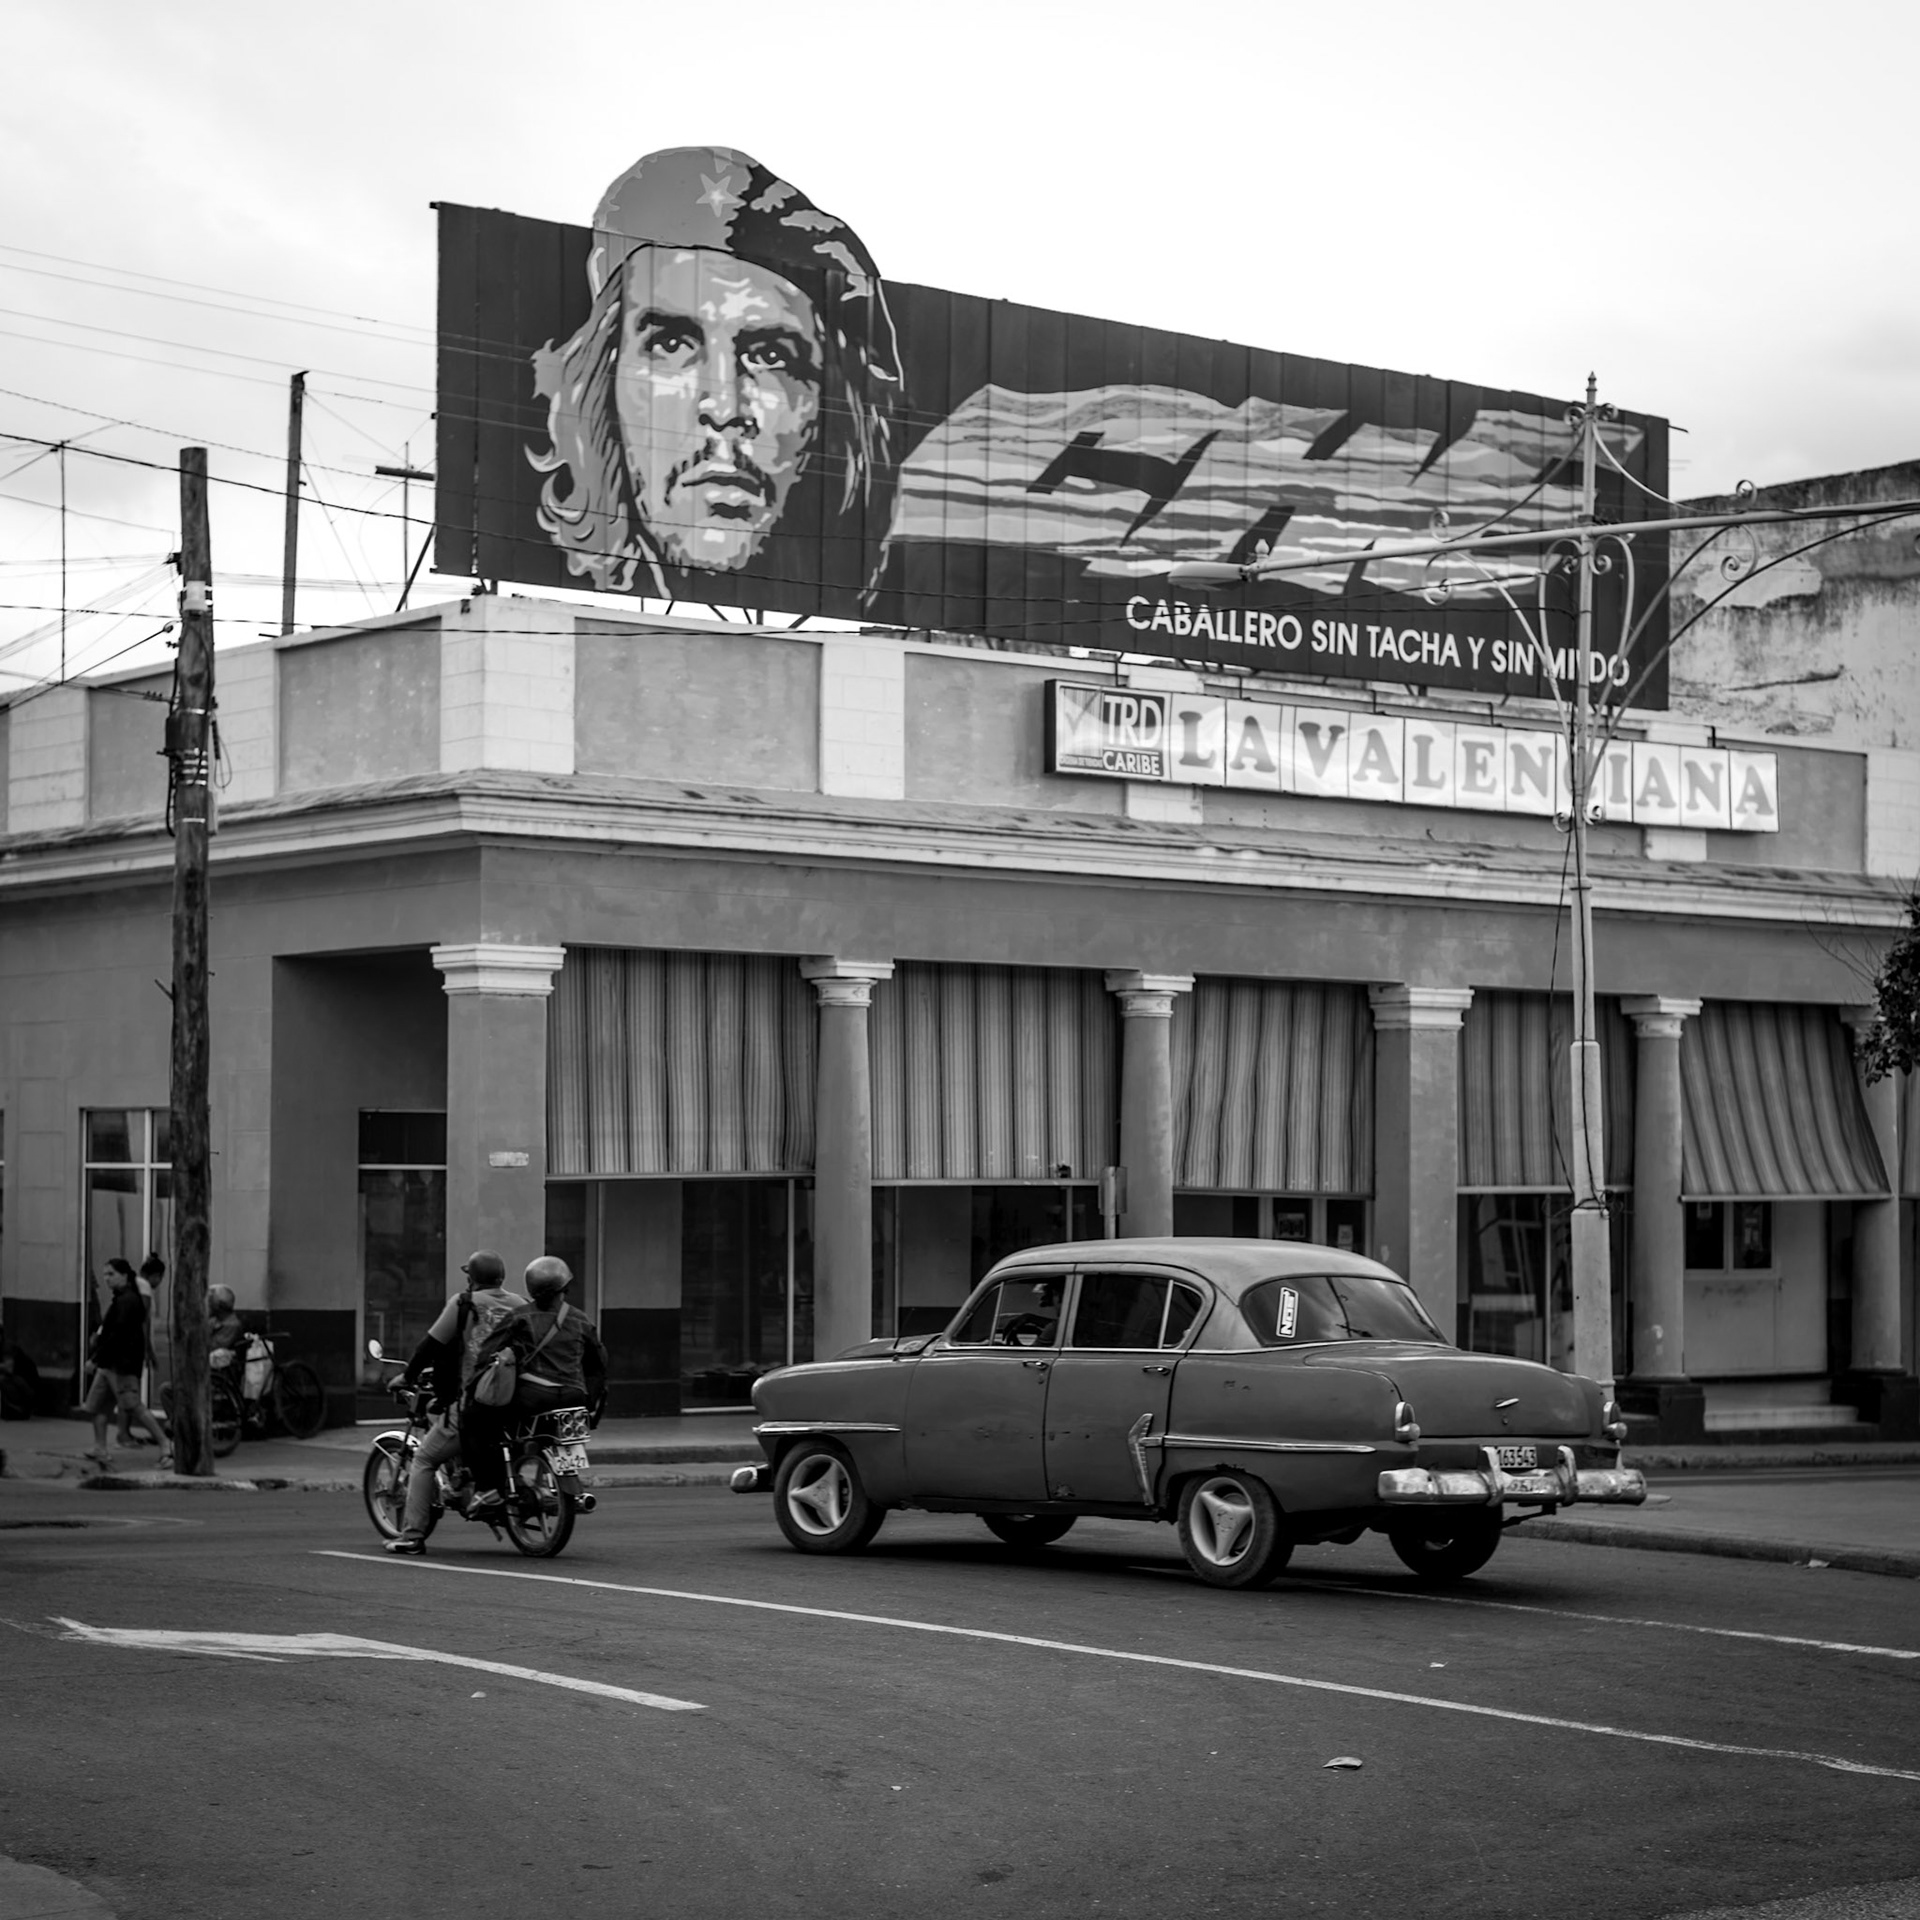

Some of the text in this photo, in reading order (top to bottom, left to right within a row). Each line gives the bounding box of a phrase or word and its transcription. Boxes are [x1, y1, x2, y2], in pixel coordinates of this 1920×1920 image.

[1126, 595, 1630, 687] CABALLERO SIN TACHA Y SIN MIDO
[1103, 695, 1163, 748] TRD
[1178, 711, 1277, 773] LA
[1103, 751, 1160, 776] CARIBE
